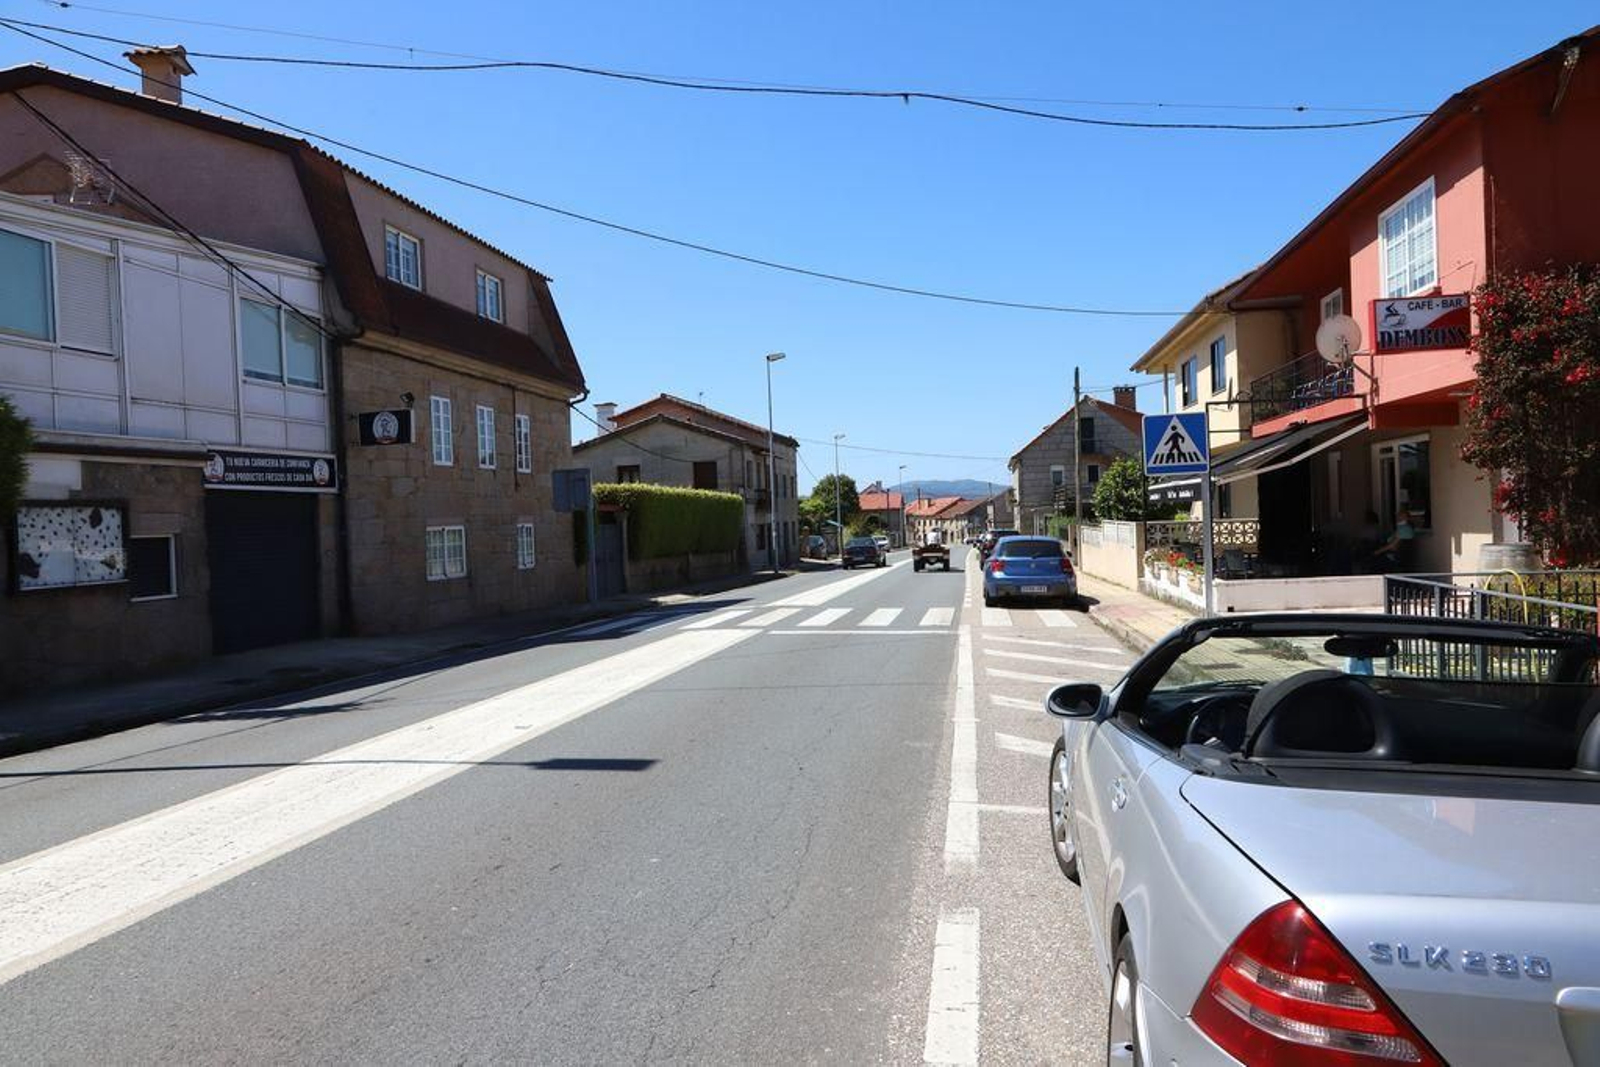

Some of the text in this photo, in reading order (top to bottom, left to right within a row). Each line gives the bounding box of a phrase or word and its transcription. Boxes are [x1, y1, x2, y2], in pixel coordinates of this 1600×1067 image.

[1442, 298, 1463, 309] BAR
[236, 473, 265, 482] PRODUCTOS
[1369, 942, 1551, 979] SLK 230
